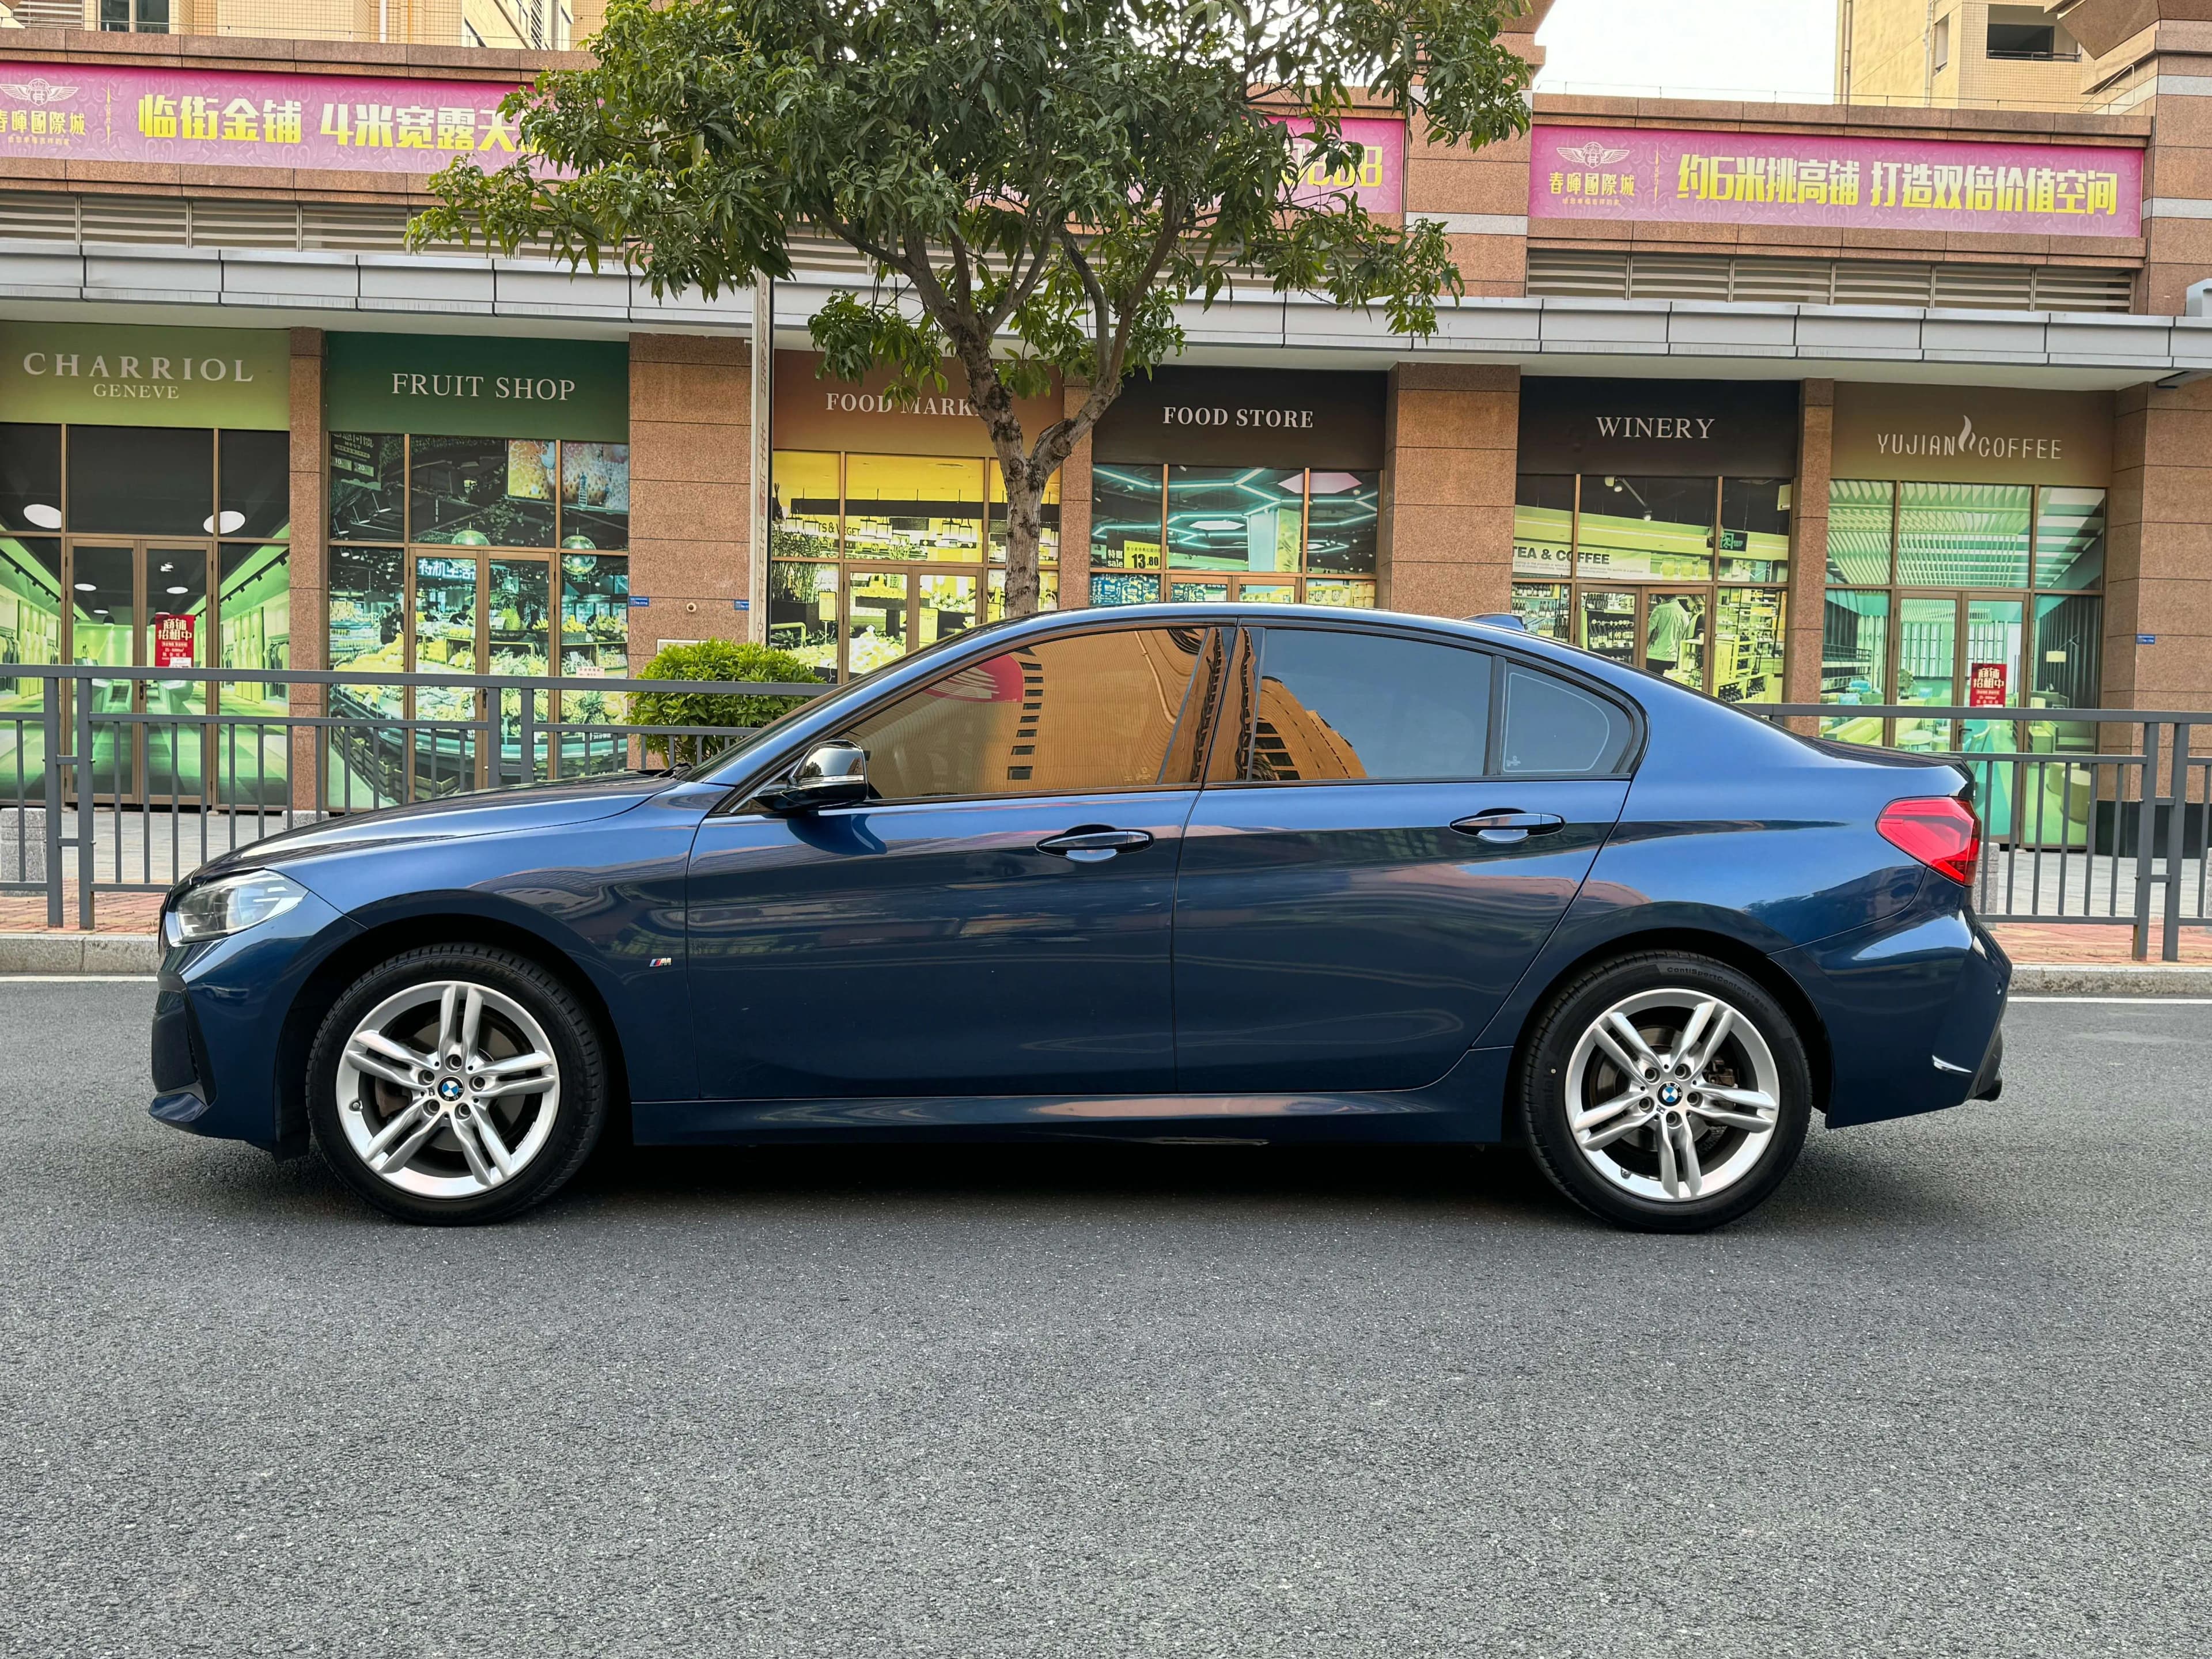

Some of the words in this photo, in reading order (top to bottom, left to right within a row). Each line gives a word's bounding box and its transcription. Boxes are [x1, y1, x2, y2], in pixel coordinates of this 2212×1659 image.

[138, 94, 302, 143] 临街金铺
[320, 103, 545, 153] 4米宽露天
[1677, 153, 1860, 206] 约6米挑高铺
[1870, 161, 2118, 215] 打造双倍价值空间
[23, 353, 253, 382] CHARRIOL
[93, 383, 179, 399] GENEVE
[392, 373, 484, 397] FRUIT
[495, 377, 575, 400] SHOP
[826, 393, 892, 412] FOOD
[900, 396, 979, 416] MARK
[1162, 407, 1228, 425] FOOD
[1236, 409, 1313, 428] STORE
[1596, 416, 1715, 439] WINERY
[1877, 434, 1955, 456] YUJIAN
[1978, 437, 2062, 459] COFFEE
[1108, 559, 1123, 567] sale
[1131, 554, 1158, 569] 13.80
[1541, 549, 1552, 560] &
